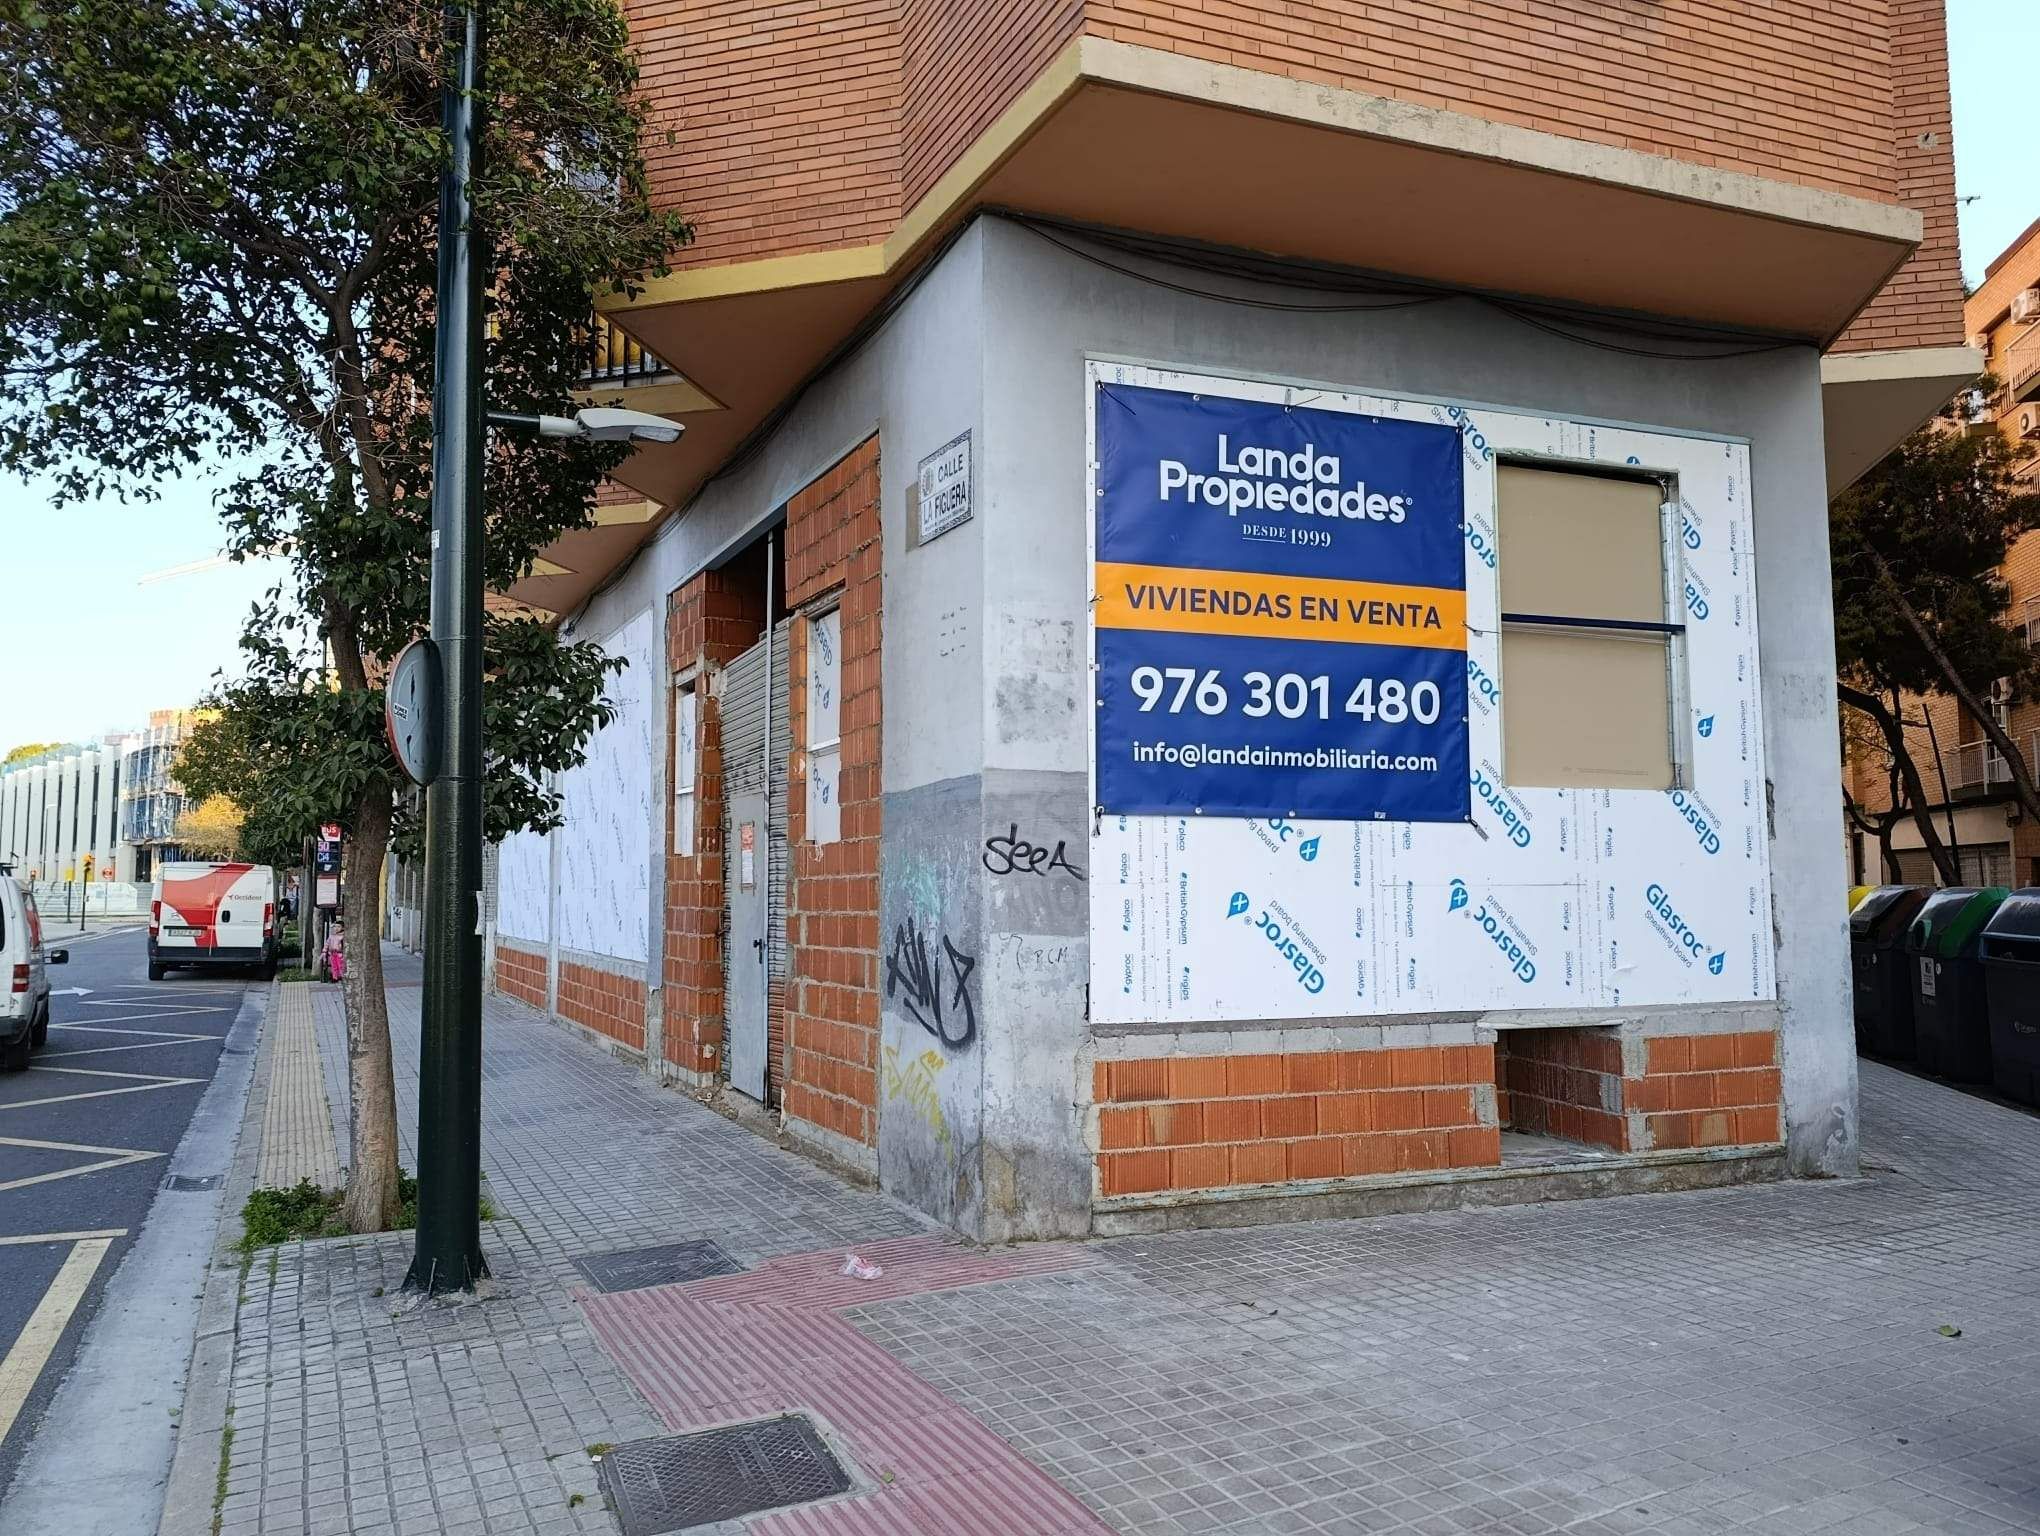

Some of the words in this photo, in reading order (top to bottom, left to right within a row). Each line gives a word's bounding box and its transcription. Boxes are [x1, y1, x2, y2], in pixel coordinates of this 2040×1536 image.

[938, 454, 963, 482] CALLE
[1218, 434, 1340, 483] Landa
[923, 500, 933, 525] LA
[935, 480, 966, 520] FIGUERA
[1242, 523, 1286, 539] DESDE
[1291, 528, 1331, 547] 1999
[1125, 584, 1292, 619] VIVIENDAS
[1301, 596, 1339, 622] EN
[1348, 600, 1442, 630] VENTA
[1131, 666, 1228, 716] 976
[1242, 671, 1329, 720] 301
[1345, 678, 1440, 725] 480
[1133, 741, 1438, 772] info@landainmobiliaria.com
[1257, 827, 1280, 854] board
[1123, 899, 1131, 923] placo
[1180, 880, 1188, 909] British
[1269, 900, 1293, 925] board
[1487, 895, 1507, 919] board
[1645, 909, 1675, 949] Sheathing
[1673, 944, 1693, 968] board
[1646, 884, 1704, 958] Glasroc
[1255, 911, 1325, 994] Glasroc
[1291, 922, 1327, 966] Sheathing
[1474, 906, 1536, 983] Glasroc
